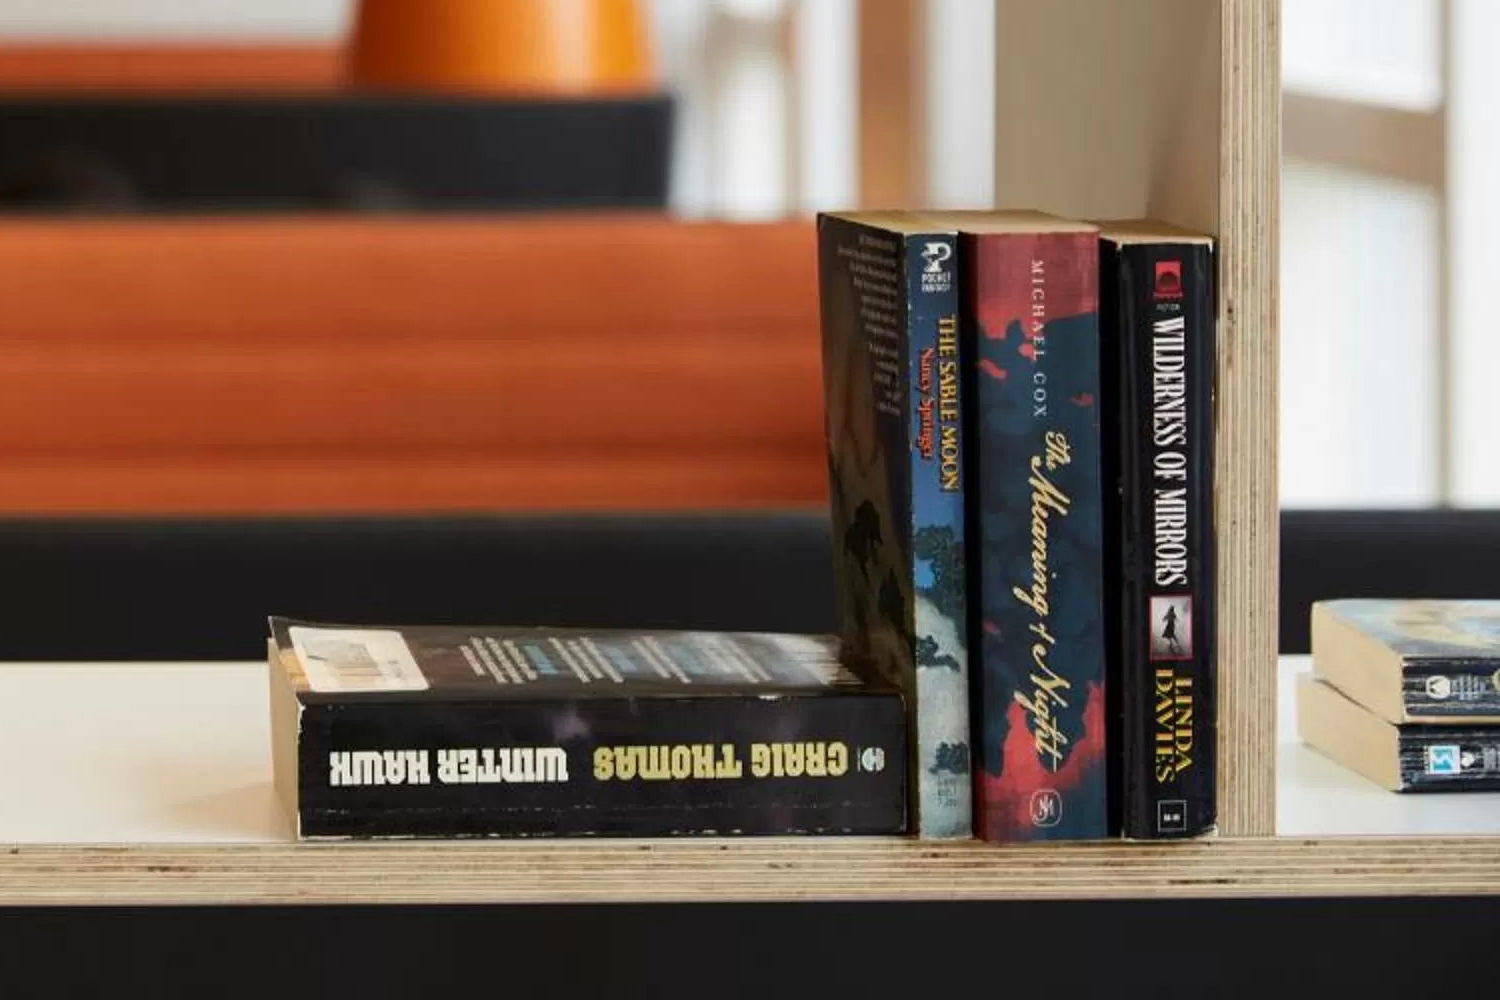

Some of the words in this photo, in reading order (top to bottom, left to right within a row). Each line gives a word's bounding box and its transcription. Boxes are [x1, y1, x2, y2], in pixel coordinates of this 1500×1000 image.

[939, 313, 957, 357] THE
[1031, 259, 1045, 361] MICHAEL
[939, 361, 958, 422] SABLE
[1033, 372, 1047, 417] COX
[1153, 316, 1187, 446] WILDERNESS
[940, 426, 960, 492] MOON
[1045, 431, 1072, 471] The
[1153, 451, 1187, 481] OF
[1012, 456, 1071, 616] Meaning
[1154, 488, 1188, 587] MIRRORS
[1014, 644, 1072, 772] Night
[1155, 669, 1176, 783] DAVIES
[1175, 678, 1193, 773] LINDA
[329, 749, 431, 787] HAWK
[437, 747, 569, 784] WINTER
[593, 744, 743, 781] THOMAS
[750, 741, 849, 778] CRAIG
